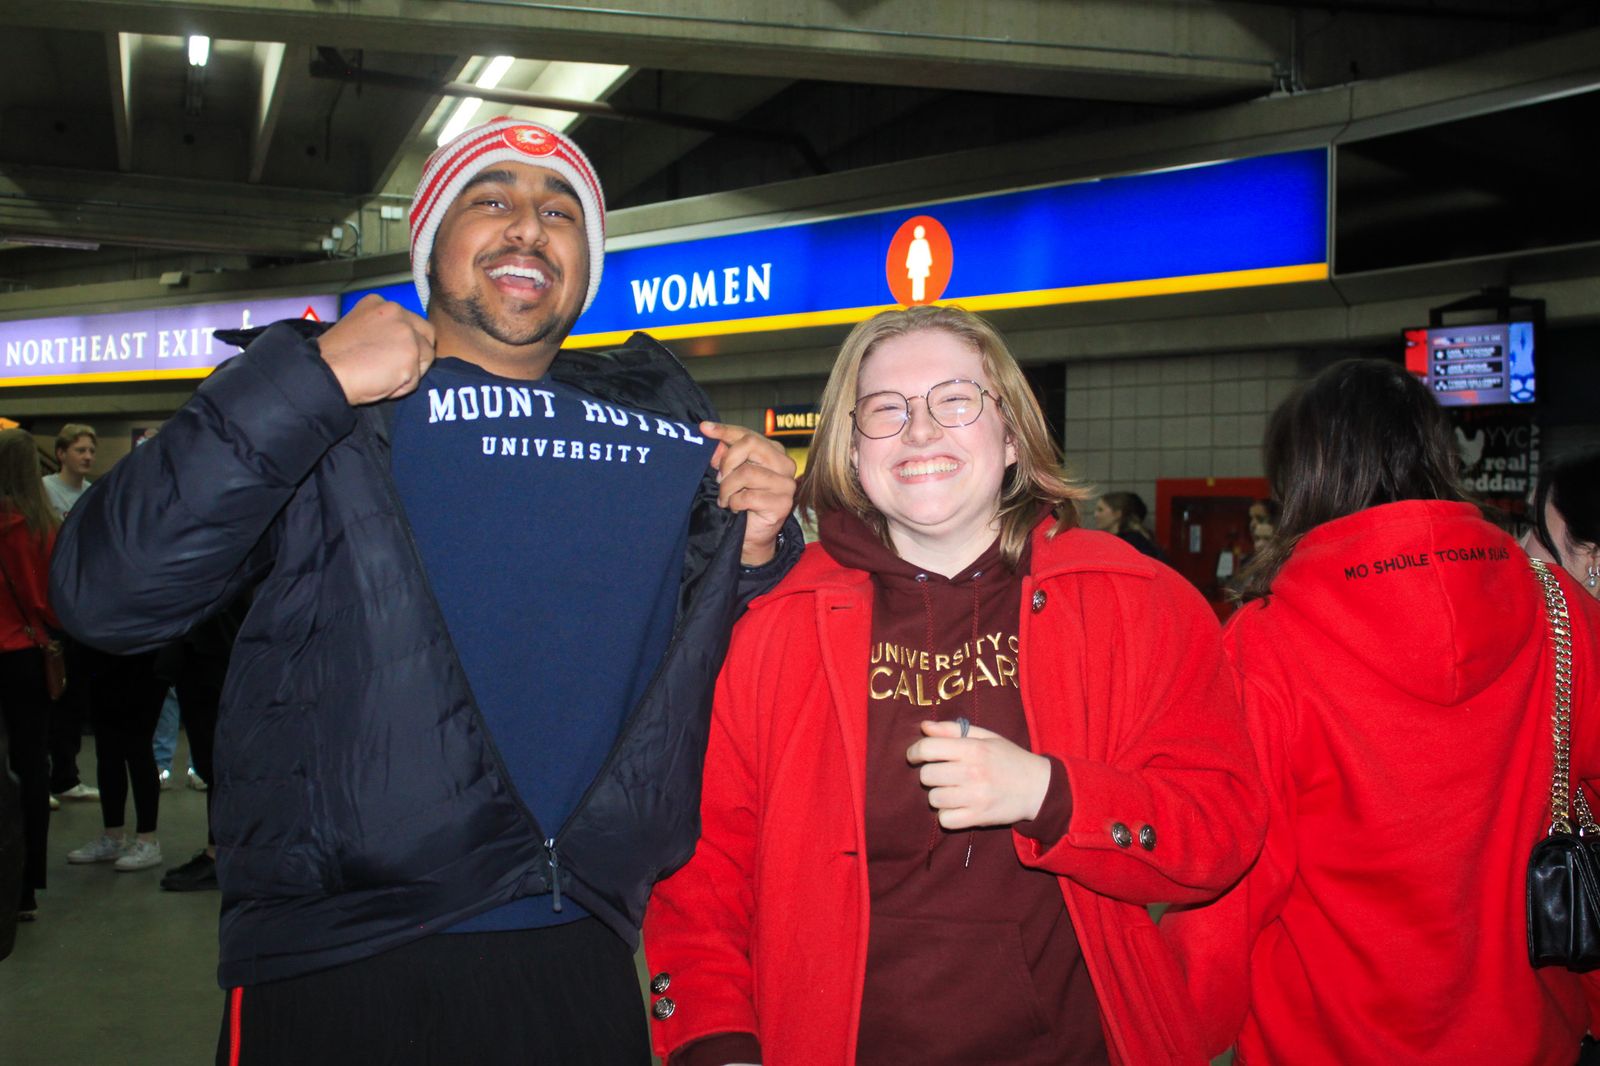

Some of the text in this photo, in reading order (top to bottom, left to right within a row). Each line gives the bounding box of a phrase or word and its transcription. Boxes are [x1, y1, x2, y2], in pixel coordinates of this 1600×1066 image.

[631, 263, 772, 314] WOMEN
[5, 326, 217, 367] NORTHEAST EXIT
[428, 385, 556, 423] MOUNT
[482, 436, 651, 464] UNIVERSITY
[1486, 425, 1529, 449] YYC
[1484, 452, 1527, 471] real
[1464, 473, 1527, 493] eddar
[1344, 563, 1370, 581] MO
[1435, 548, 1487, 563] TOGAM
[871, 632, 1019, 671] UNIVERSITY O
[870, 654, 1019, 706] CALGAR
